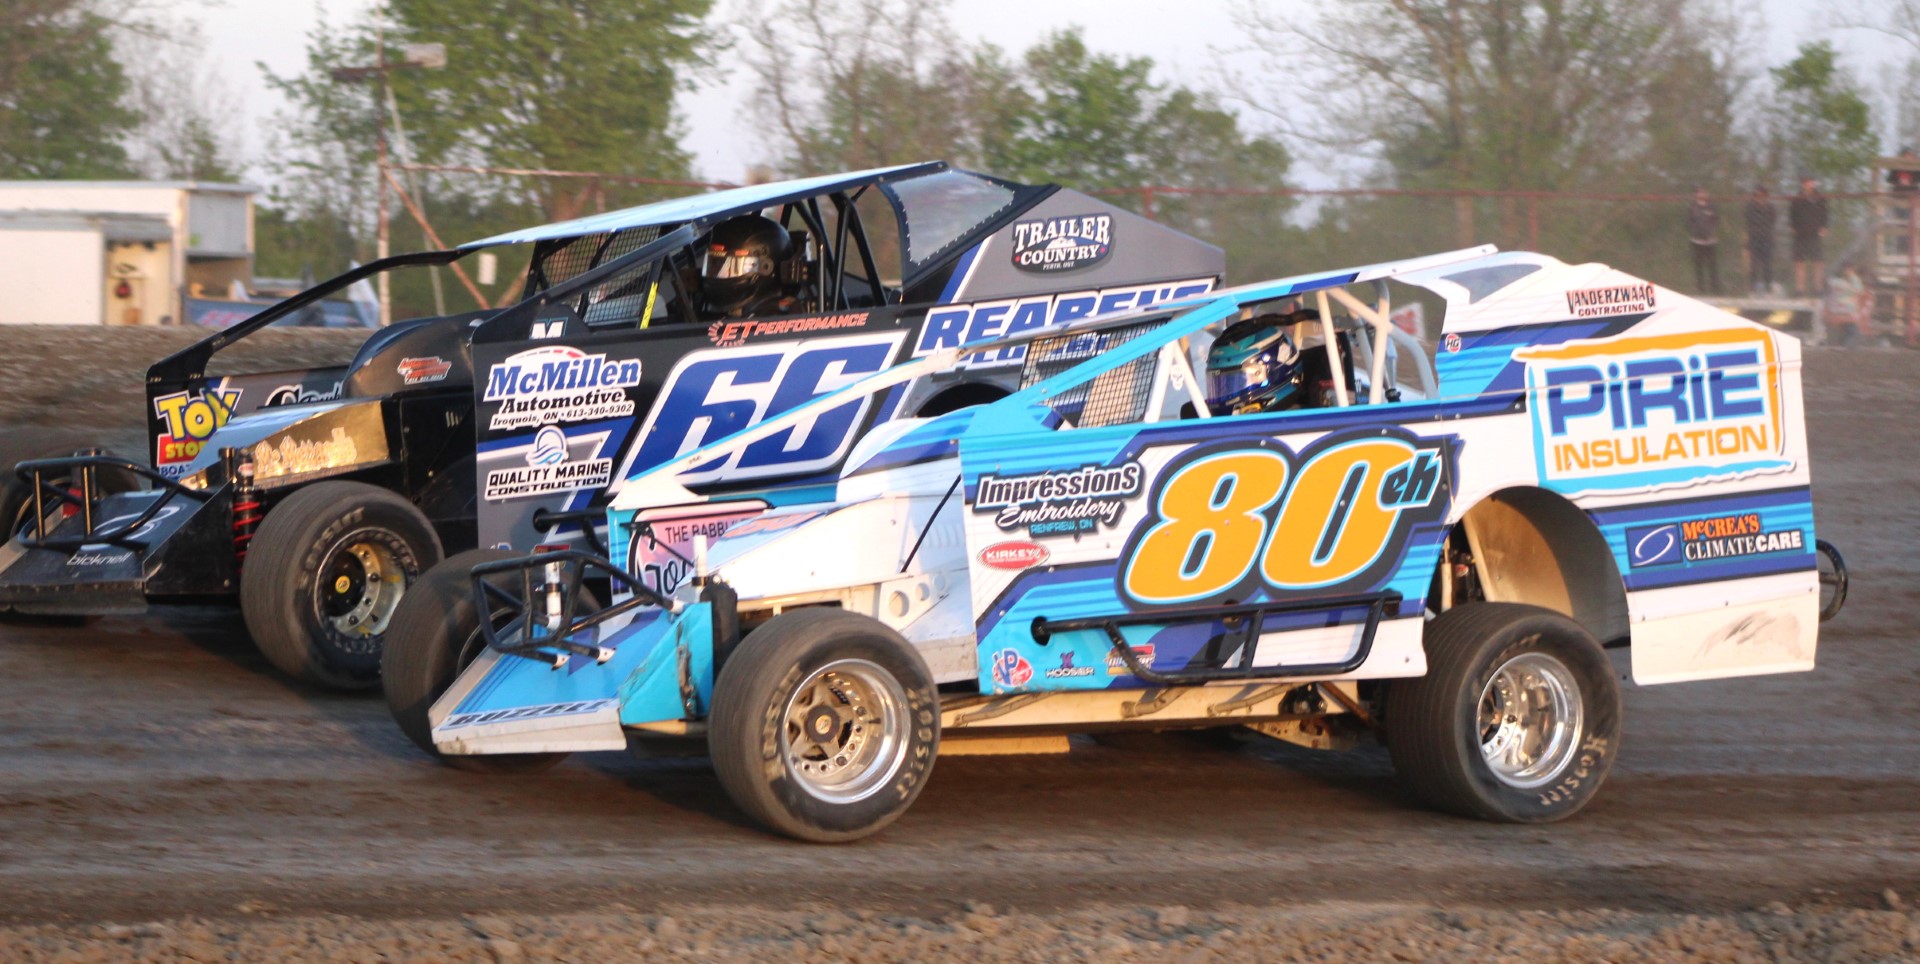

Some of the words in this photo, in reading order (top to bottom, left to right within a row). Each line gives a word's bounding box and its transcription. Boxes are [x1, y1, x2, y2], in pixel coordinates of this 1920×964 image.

[1014, 215, 1111, 254] TRAILER
[1020, 243, 1100, 266] COUNTRY
[1565, 284, 1656, 315] VANDERZWAAG
[1578, 303, 1645, 317] CONTRACTING
[716, 320, 759, 346] ET
[753, 312, 870, 337] PERFORMANCE
[487, 356, 640, 398] McMillen
[158, 390, 238, 441] TOY
[492, 413, 541, 427] Iroquois,
[543, 411, 559, 421] ON
[565, 403, 633, 418] 613-340-9302
[501, 389, 623, 415] Automotive
[622, 341, 895, 476] 66
[1553, 423, 1769, 473] INSULATION
[486, 475, 608, 497] CONSTRUCTION
[488, 467, 551, 487] QUALITY
[555, 461, 610, 480] MARINE
[997, 496, 1122, 528] Embroidery
[1126, 440, 1412, 600] 80
[664, 525, 689, 543] THE
[1029, 520, 1078, 535] RENFREW,
[1079, 518, 1094, 530] ON
[1681, 513, 1760, 541] McCREA'S
[66, 551, 134, 566] bicknell
[986, 548, 1035, 560] KIRKEY
[1685, 530, 1803, 561] CLIMATECARE
[1045, 665, 1095, 678] HOOSIER
